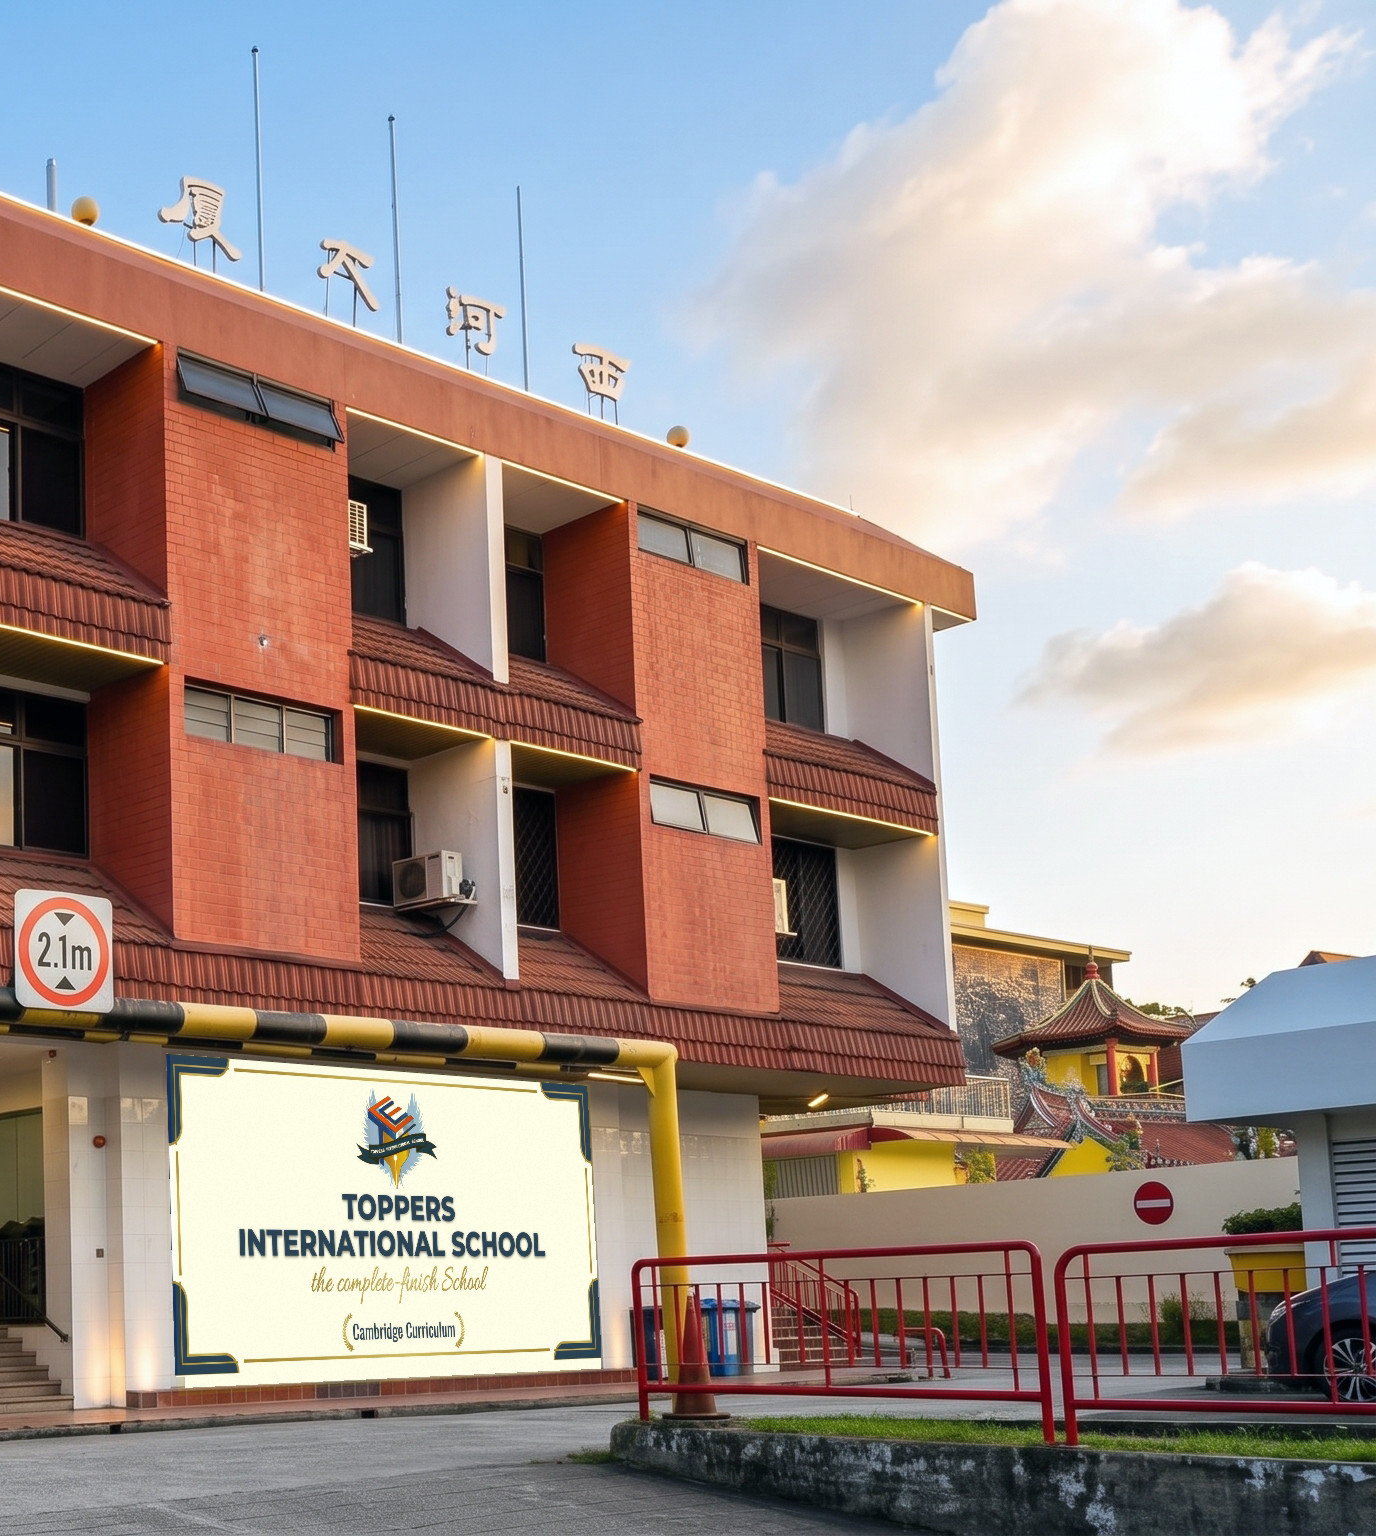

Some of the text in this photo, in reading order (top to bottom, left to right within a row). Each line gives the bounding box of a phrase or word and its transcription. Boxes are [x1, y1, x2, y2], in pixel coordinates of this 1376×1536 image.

[37, 930, 92, 971] 2.1m
[342, 1193, 456, 1222] TOPPERS
[239, 1228, 546, 1258] INTERNATIONAL SCHOOL
[311, 1265, 489, 1305] the complete-finish School
[352, 1321, 456, 1343] Cambridge Curriculum
